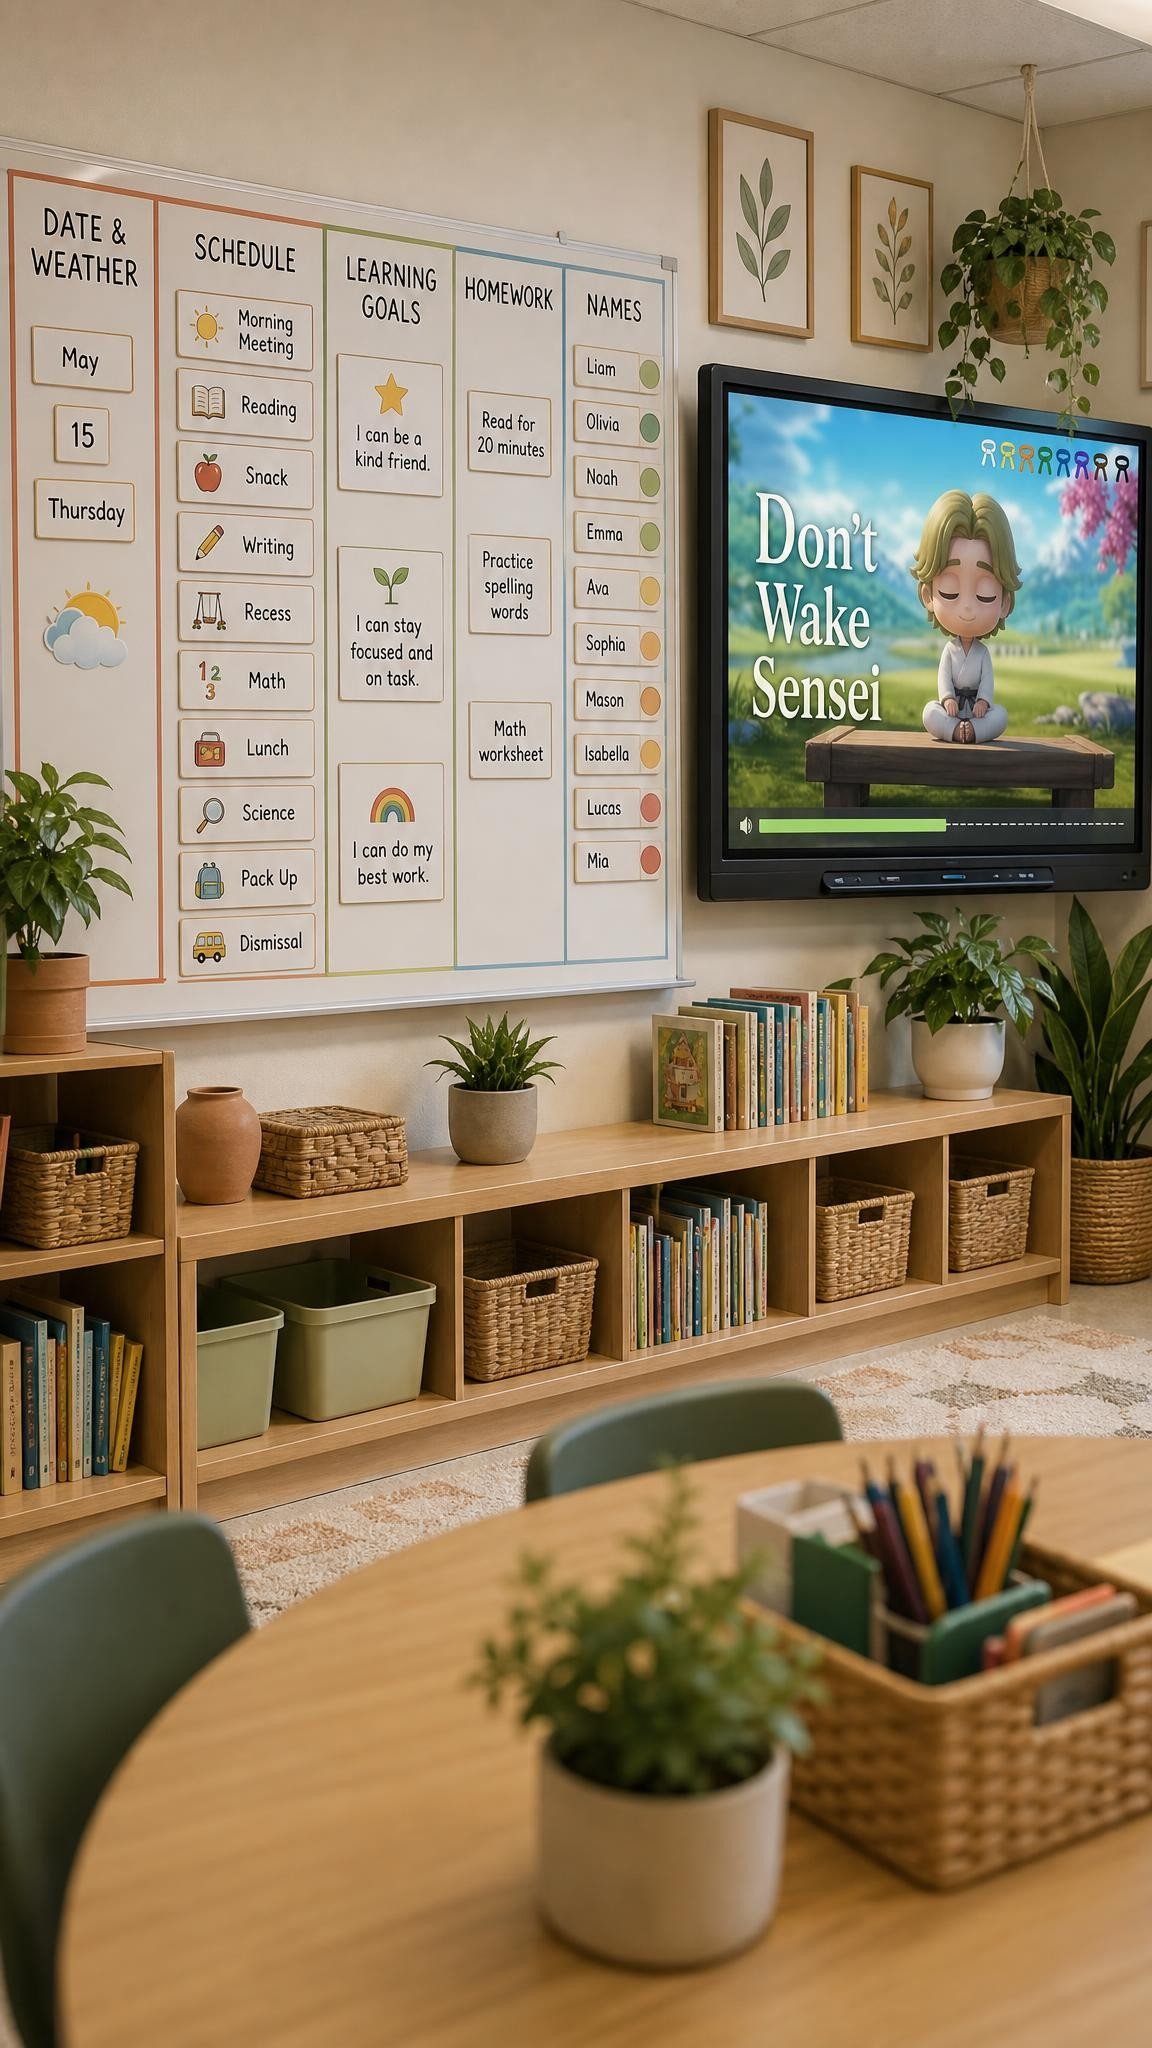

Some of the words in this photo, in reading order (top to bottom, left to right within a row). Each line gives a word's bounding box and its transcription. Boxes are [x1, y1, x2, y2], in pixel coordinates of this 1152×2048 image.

[44, 207, 103, 243] DATE
[111, 217, 127, 246] &
[194, 233, 296, 273] SCHEDULE
[30, 247, 138, 288] WEATHER
[346, 255, 437, 292] LEARNING
[465, 275, 554, 311] HOMEWORK
[361, 294, 421, 325] GOALS
[587, 292, 642, 323] NAMES
[238, 308, 293, 336] Morning
[239, 333, 294, 361] Meeting
[62, 345, 99, 377] May
[587, 356, 616, 377] Liam
[241, 395, 297, 424] Reading
[482, 410, 513, 431] Read
[517, 414, 536, 433] for
[586, 412, 620, 432] Olivia
[71, 421, 95, 449] 15
[356, 423, 360, 441] I
[365, 430, 389, 444] can
[393, 426, 410, 445] be
[413, 434, 422, 447] a
[477, 435, 494, 454] 20
[497, 439, 545, 458] minutes
[355, 449, 383, 468] kind
[387, 451, 430, 472] friend.
[245, 465, 289, 487] Snack
[586, 467, 618, 487] Noah
[47, 497, 126, 528] Thursday
[587, 522, 623, 542] Emma
[756, 492, 877, 573] Don't
[242, 535, 294, 562] Writing
[482, 550, 534, 570] Practice
[484, 577, 533, 601] spelling
[586, 578, 609, 596] Ava
[245, 602, 292, 622] Recess
[490, 602, 529, 620] words
[755, 581, 870, 649] Wake
[356, 614, 360, 632] I
[365, 620, 389, 633] can
[393, 617, 422, 640] stay
[350, 641, 403, 661] focused
[408, 643, 433, 661] and
[586, 633, 626, 657] Sophia
[198, 660, 206, 682] 1
[210, 665, 222, 682] 2
[248, 671, 286, 690] Math
[365, 673, 382, 686] on
[386, 669, 419, 687] task.
[205, 682, 216, 701] 3
[585, 690, 624, 708] Mason
[753, 656, 881, 721] Sensei
[494, 719, 527, 737] Math
[247, 738, 289, 757] Lunch
[478, 744, 544, 762] worksheet
[585, 744, 630, 762] Isabella
[242, 803, 295, 822] Science
[587, 799, 622, 816] Lucas
[353, 840, 357, 859] I
[362, 845, 387, 859] can
[391, 839, 409, 858] do
[413, 844, 434, 862] my
[587, 852, 610, 869] Mia
[241, 868, 274, 888] Pack
[279, 868, 298, 891] Up
[357, 867, 388, 886] best
[392, 865, 429, 884] work.
[240, 931, 303, 952] Dismissal
